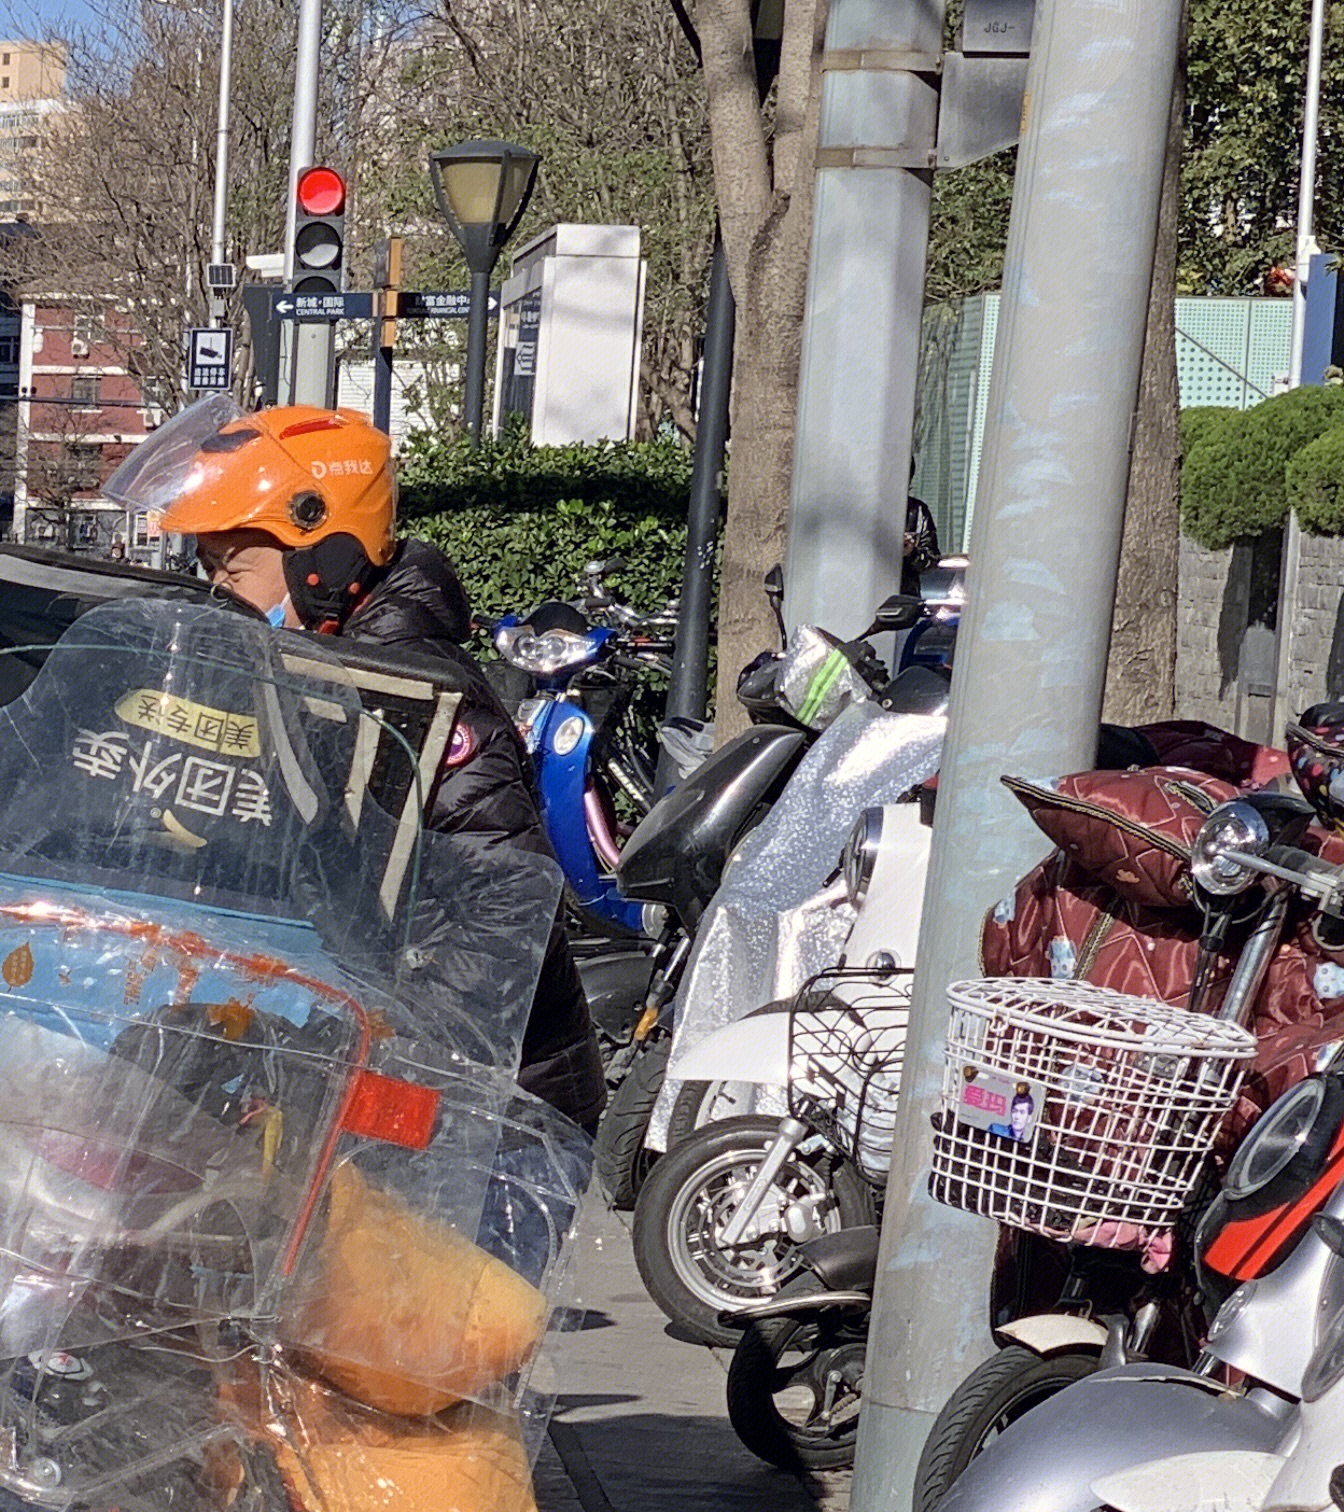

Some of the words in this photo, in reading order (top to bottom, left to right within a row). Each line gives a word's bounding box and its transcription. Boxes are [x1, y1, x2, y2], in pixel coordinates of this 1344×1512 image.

[296, 308, 325, 316] CENTRAL
[138, 694, 255, 750] 美团专送
[72, 727, 272, 826] 美团外卖
